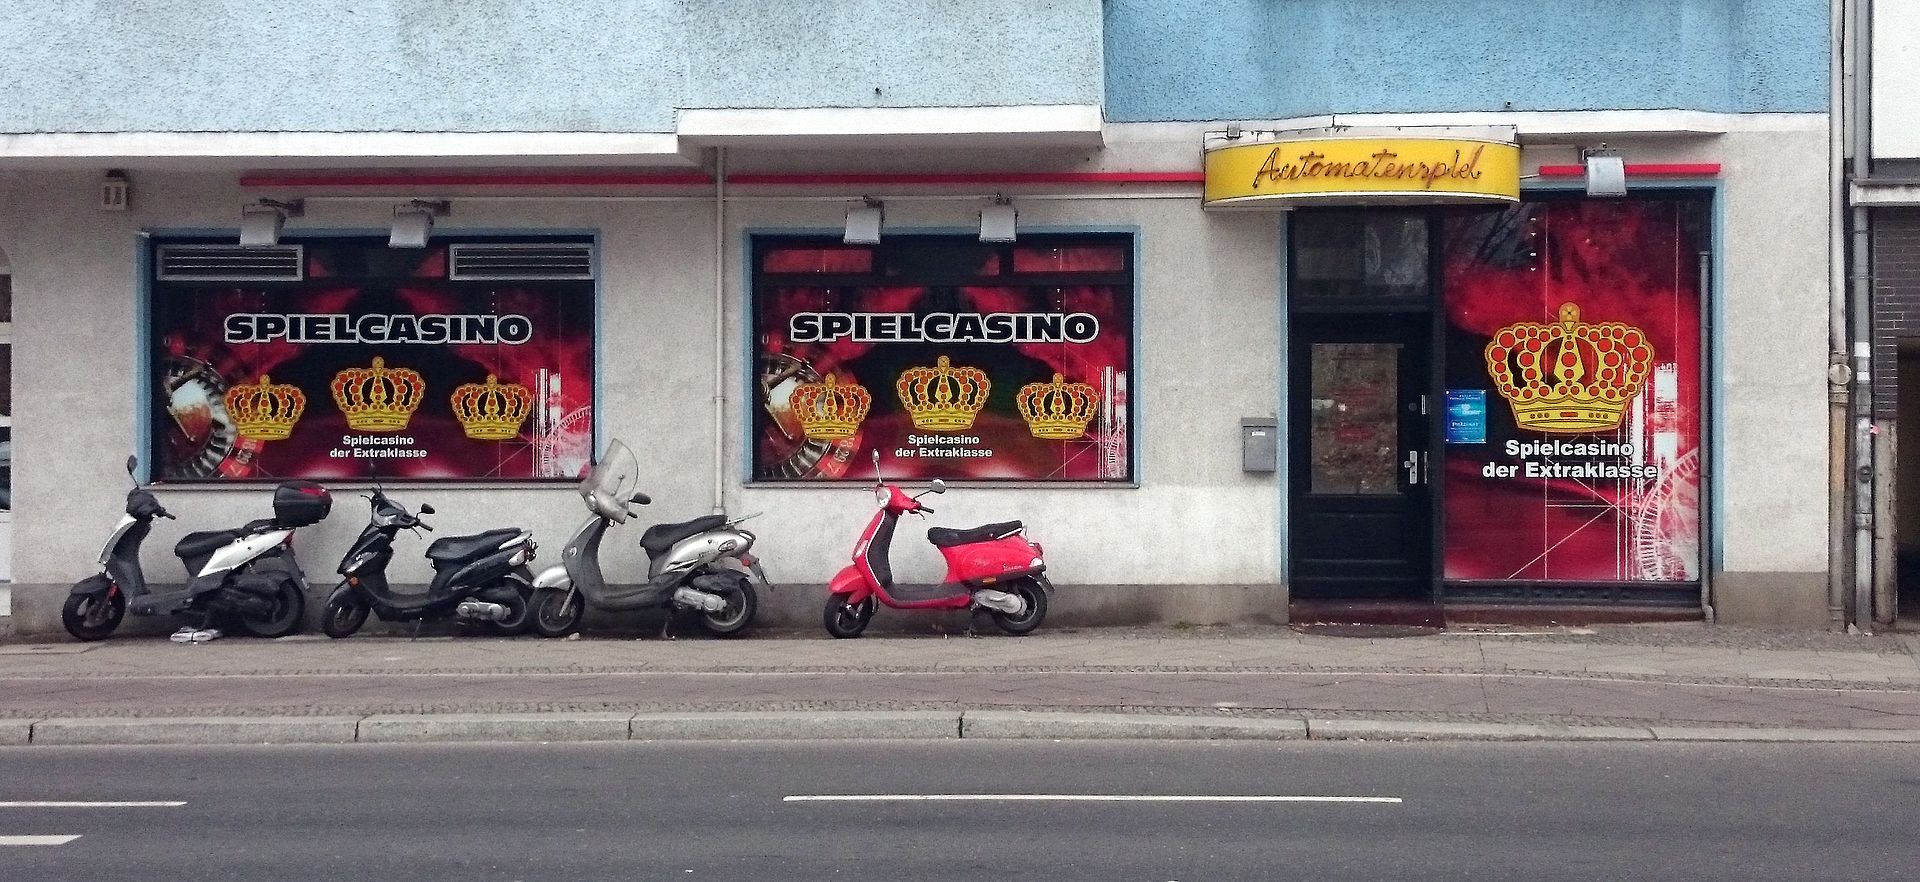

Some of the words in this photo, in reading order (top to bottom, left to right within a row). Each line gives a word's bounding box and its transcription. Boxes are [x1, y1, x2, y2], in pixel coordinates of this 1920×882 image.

[224, 313, 533, 345] SPIELCASINO
[790, 312, 1100, 344] SPIELCASINO
[342, 434, 415, 446] Spielcasino
[908, 434, 980, 446] Spielcasino
[329, 447, 353, 459] der
[355, 447, 427, 459] Extraklasse
[895, 447, 917, 459] der
[919, 447, 993, 459] Extraklasse
[1506, 440, 1635, 458] Spielcasino
[1482, 461, 1518, 478] der
[1524, 461, 1658, 478] Extraklasse
